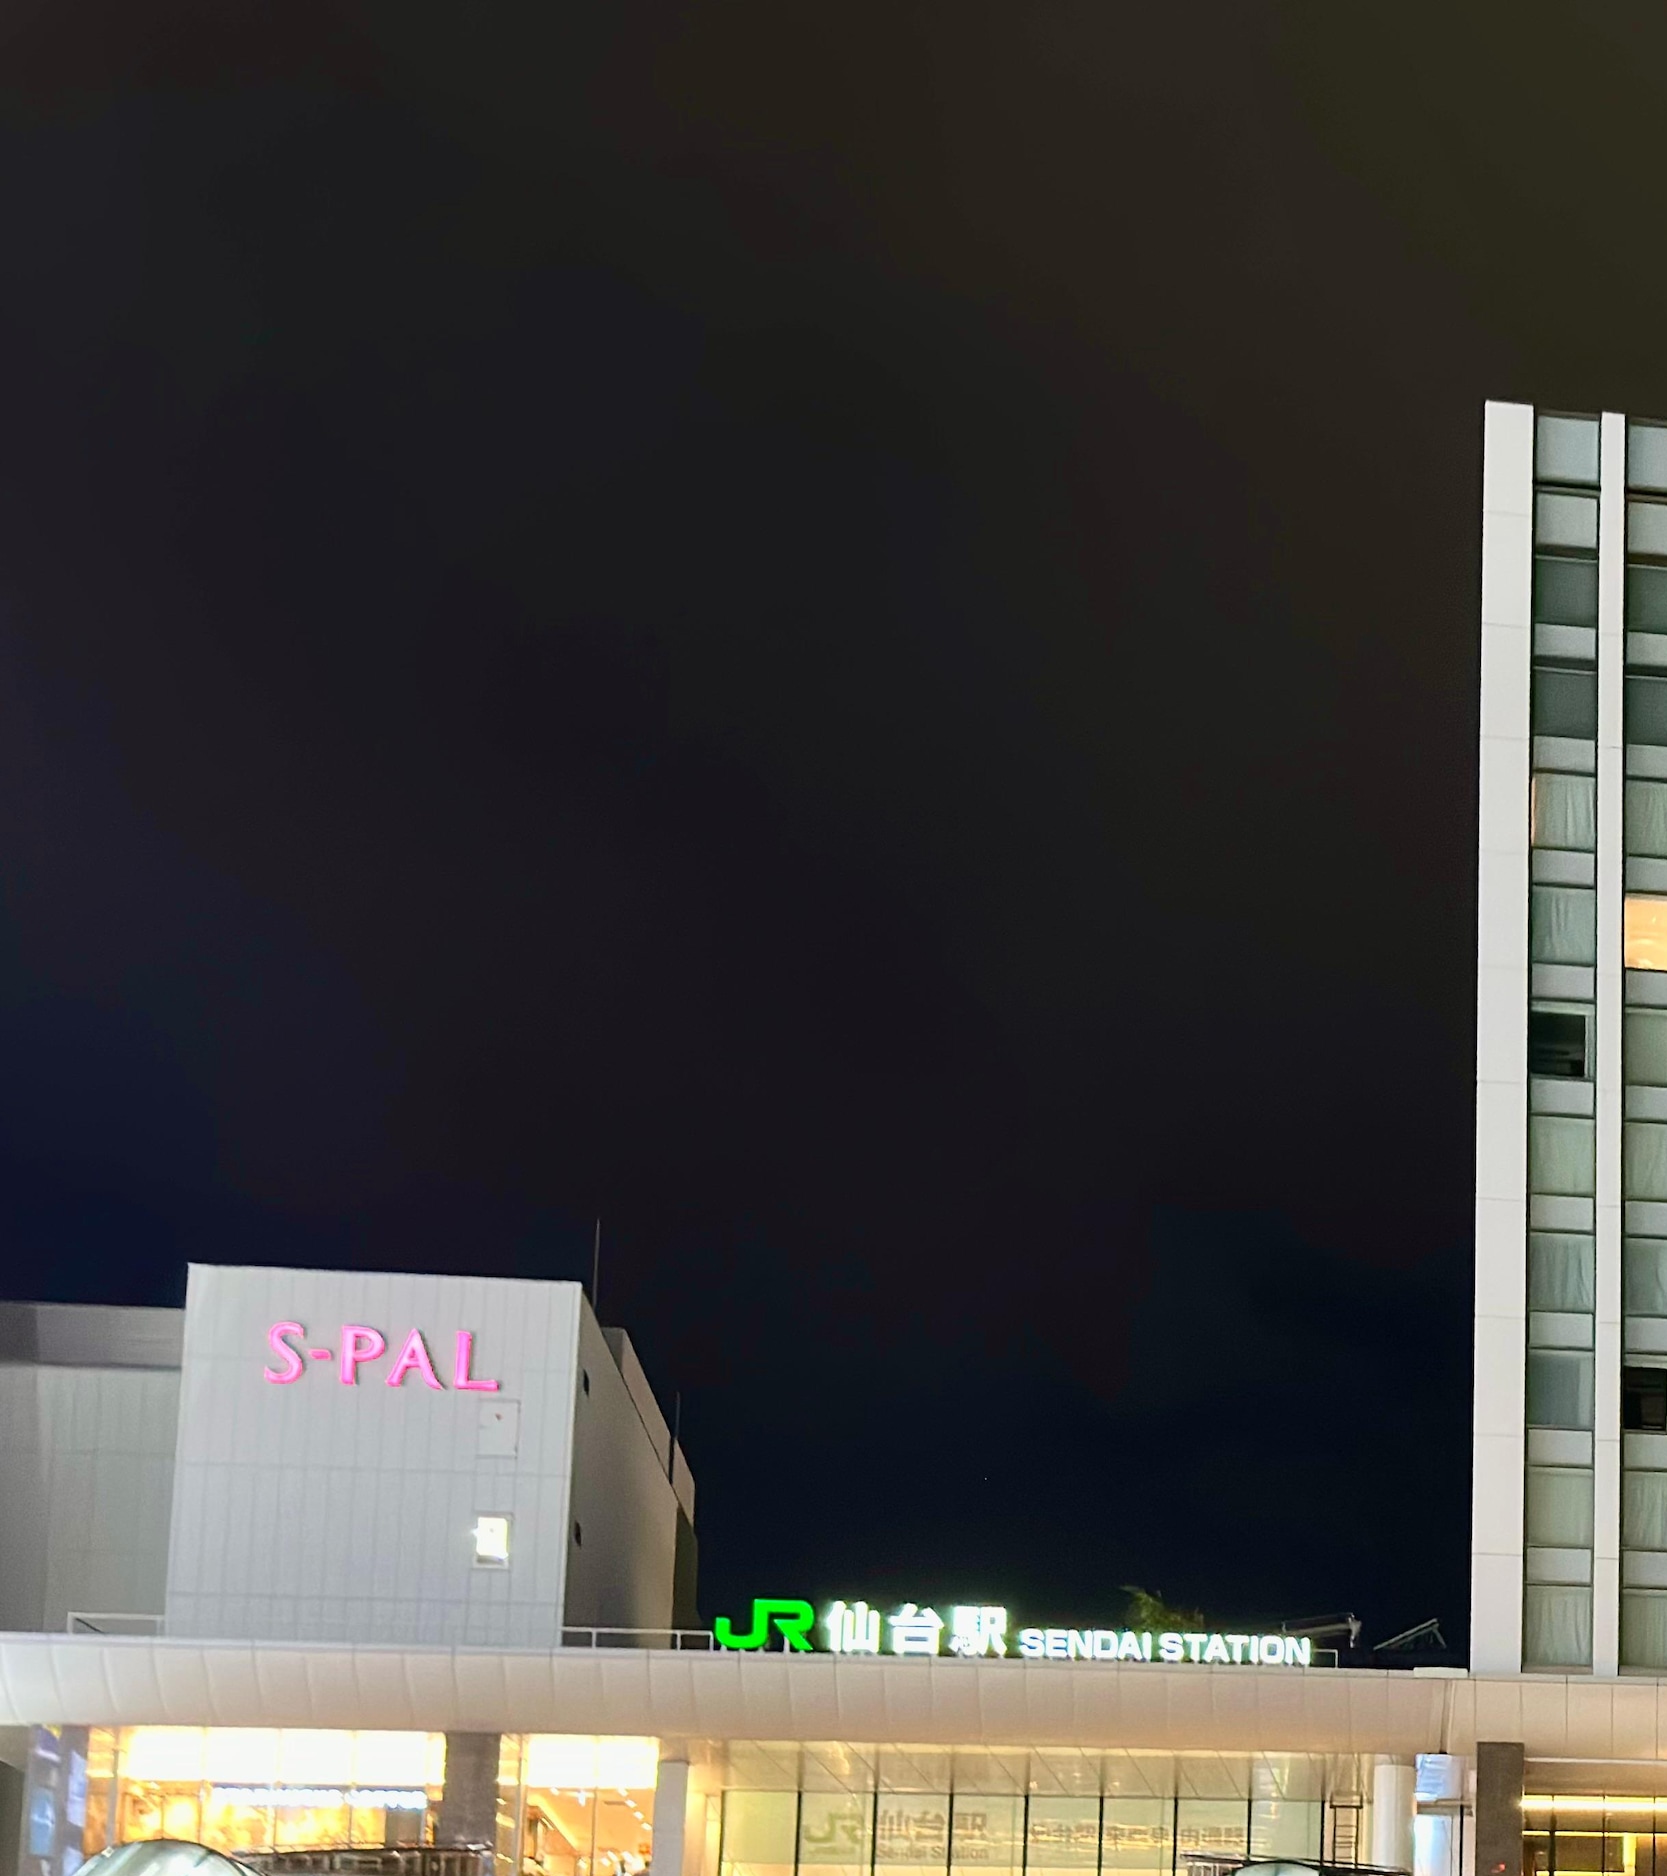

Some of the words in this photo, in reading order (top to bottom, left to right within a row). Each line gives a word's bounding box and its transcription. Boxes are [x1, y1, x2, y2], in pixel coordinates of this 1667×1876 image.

[263, 1320, 500, 1392] S-PAL
[715, 1598, 815, 1651] JR
[826, 1600, 1007, 1657] 仙台駅
[1020, 1627, 1152, 1662] SENDAI
[1158, 1632, 1311, 1666] STATION
